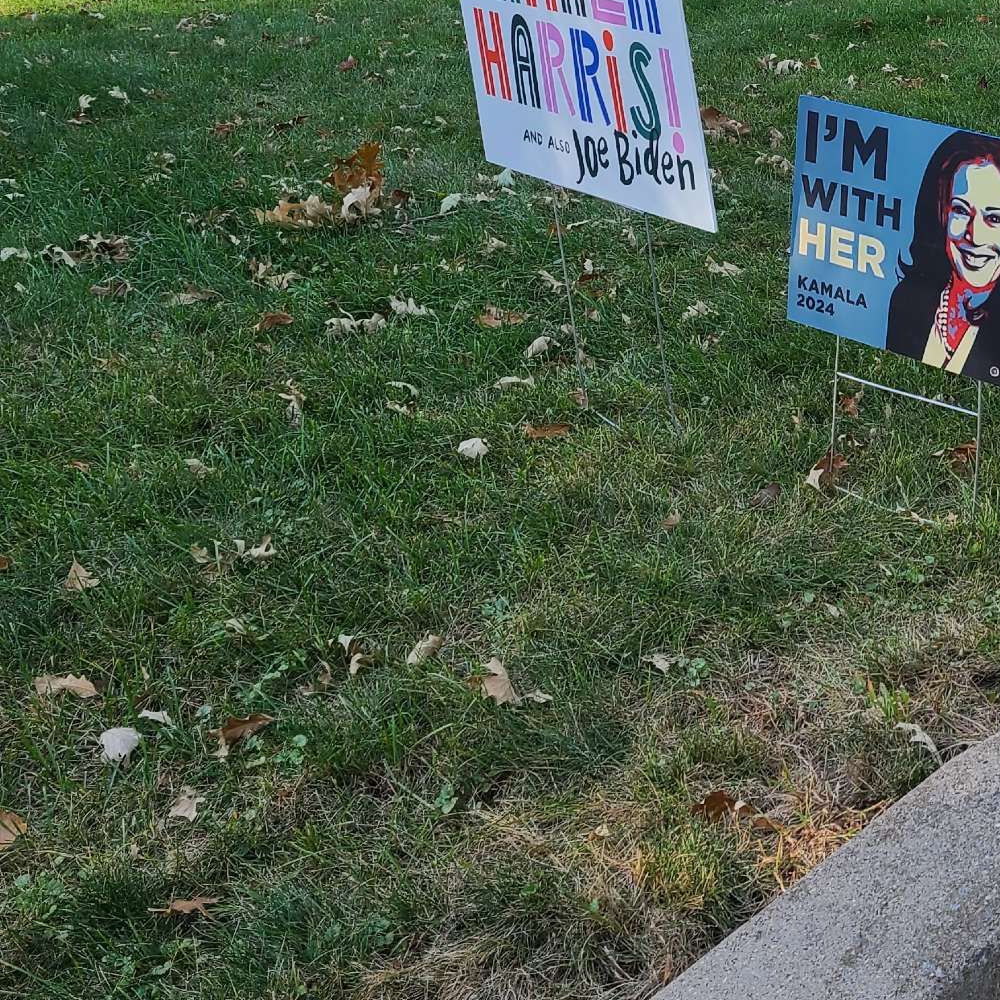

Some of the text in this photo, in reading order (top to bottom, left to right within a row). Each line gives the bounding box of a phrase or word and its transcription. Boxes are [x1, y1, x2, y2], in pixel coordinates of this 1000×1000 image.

[523, 128, 696, 191] AND ALSO Joe Biden
[805, 110, 889, 181] I'M
[801, 174, 902, 232] WITH
[798, 217, 886, 279] HER
[796, 294, 835, 316] 2024
[797, 275, 867, 309] KAMALA
